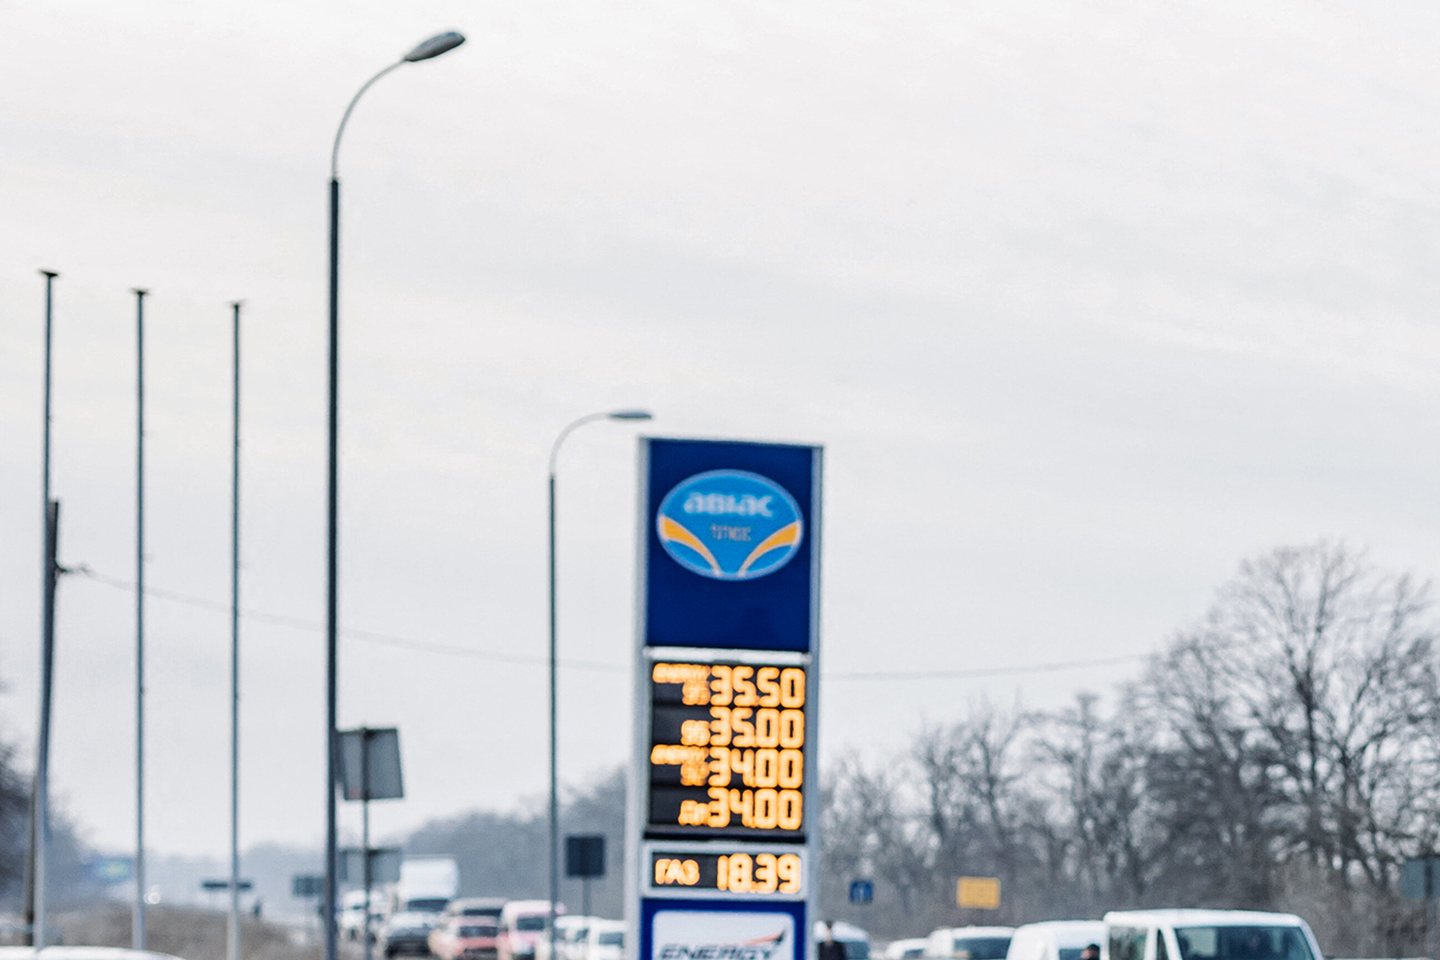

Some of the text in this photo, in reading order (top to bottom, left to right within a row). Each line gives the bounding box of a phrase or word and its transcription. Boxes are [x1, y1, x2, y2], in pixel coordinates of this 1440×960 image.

[710, 665, 805, 708] 35.50
[710, 706, 804, 748] 35.00
[708, 747, 803, 789] 34.00
[707, 787, 803, 830] 34.00
[717, 853, 801, 894] 18.39
